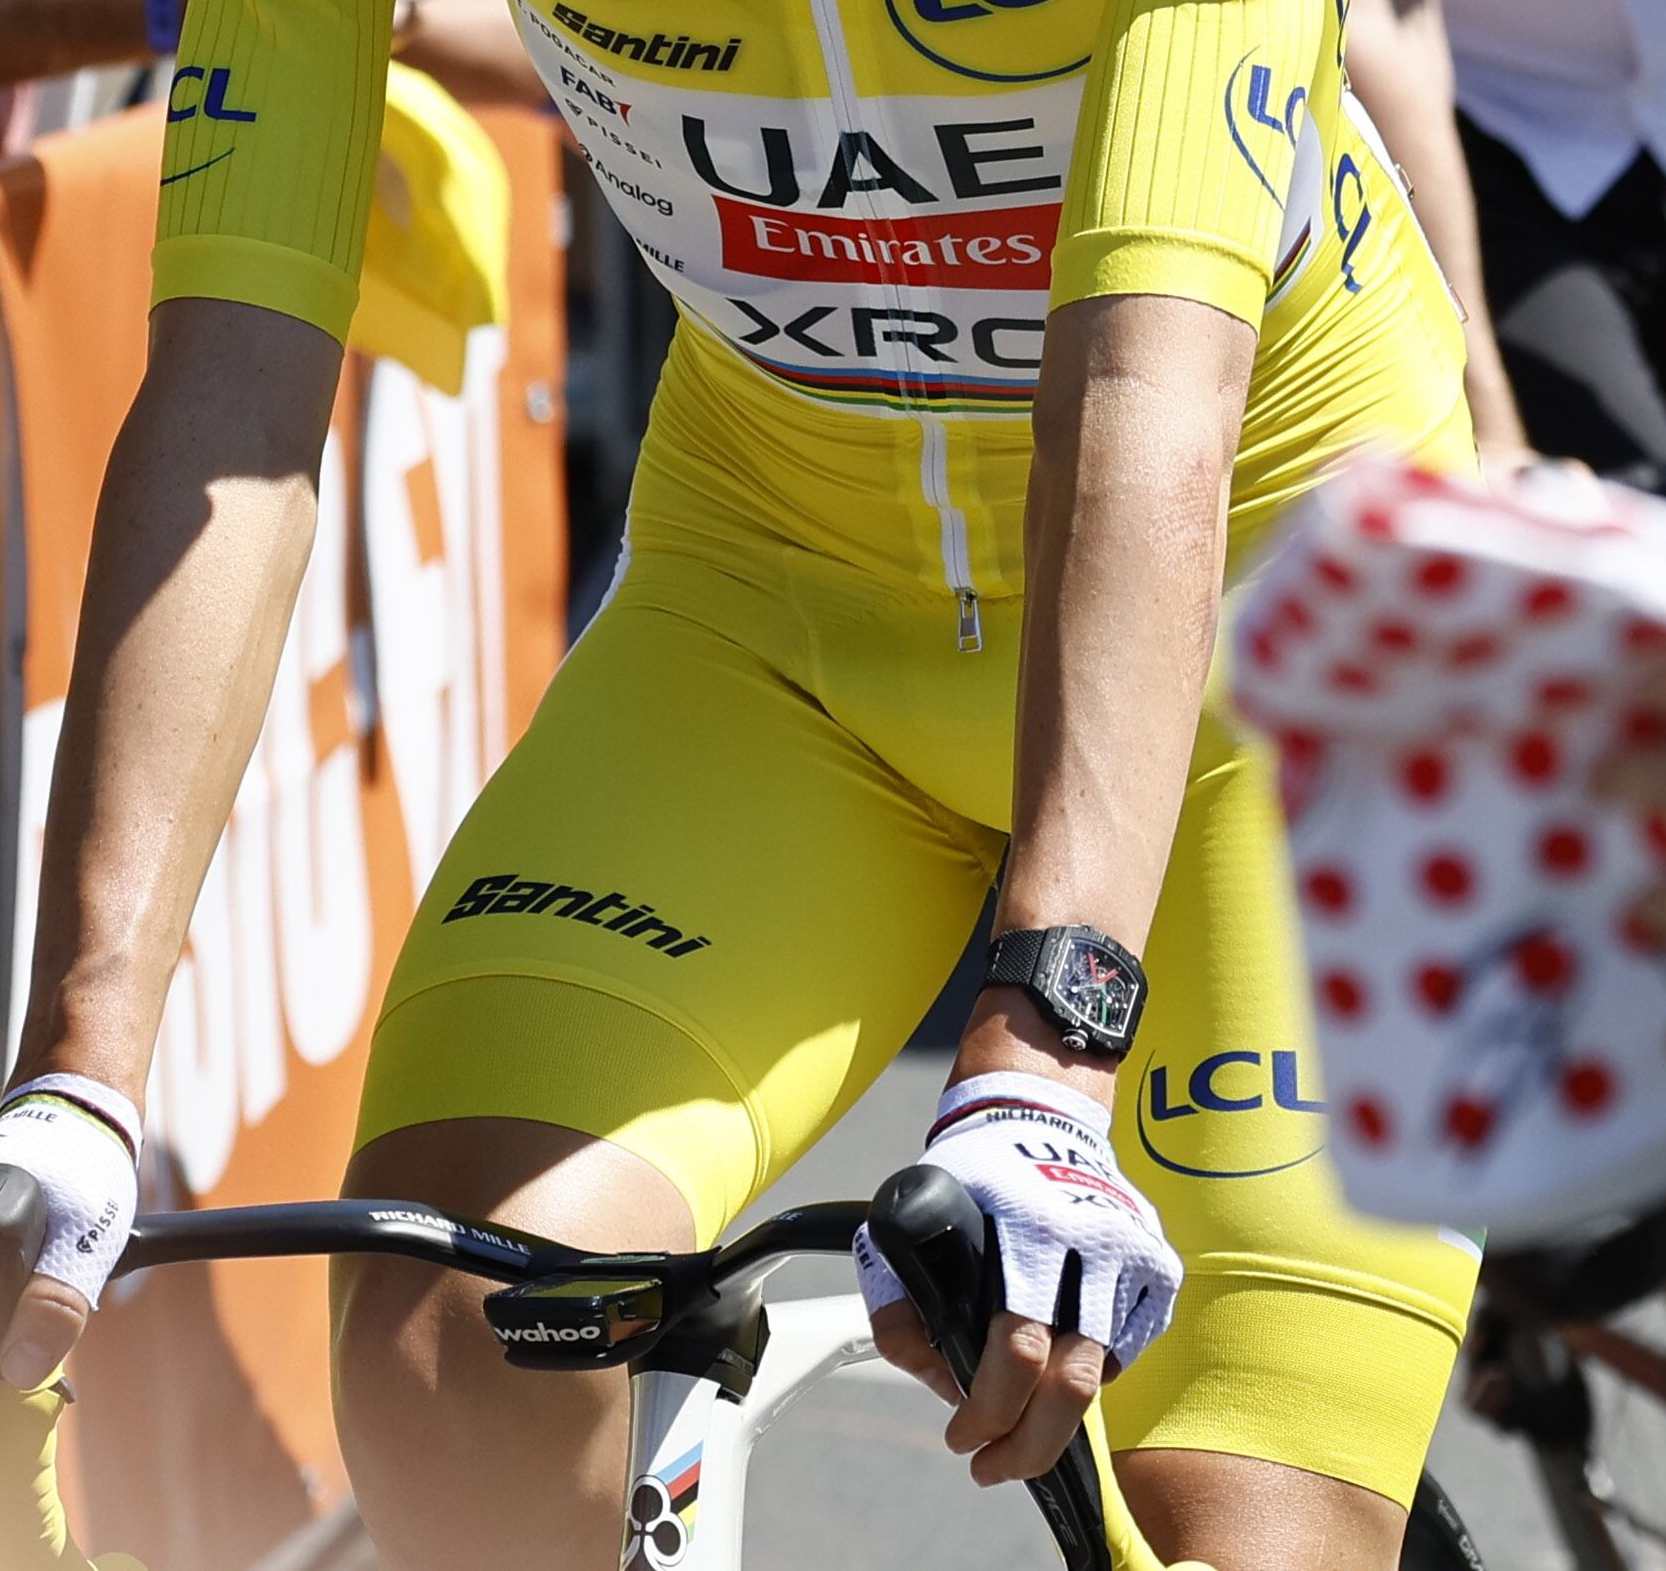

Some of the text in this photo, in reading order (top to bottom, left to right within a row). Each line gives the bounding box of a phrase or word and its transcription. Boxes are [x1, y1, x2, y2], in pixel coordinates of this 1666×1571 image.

[166, 66, 257, 122] CL
[1247, 64, 1306, 151] LC
[587, 116, 663, 170] PISSEI
[681, 114, 1062, 208] UAE
[595, 160, 674, 216] Analog
[748, 215, 1043, 268] Emirates
[442, 875, 714, 958] Santini
[1150, 1050, 1331, 1122] LCL
[369, 1210, 531, 1256] RICHARD MILLE
[494, 1322, 601, 1343] wahoo
